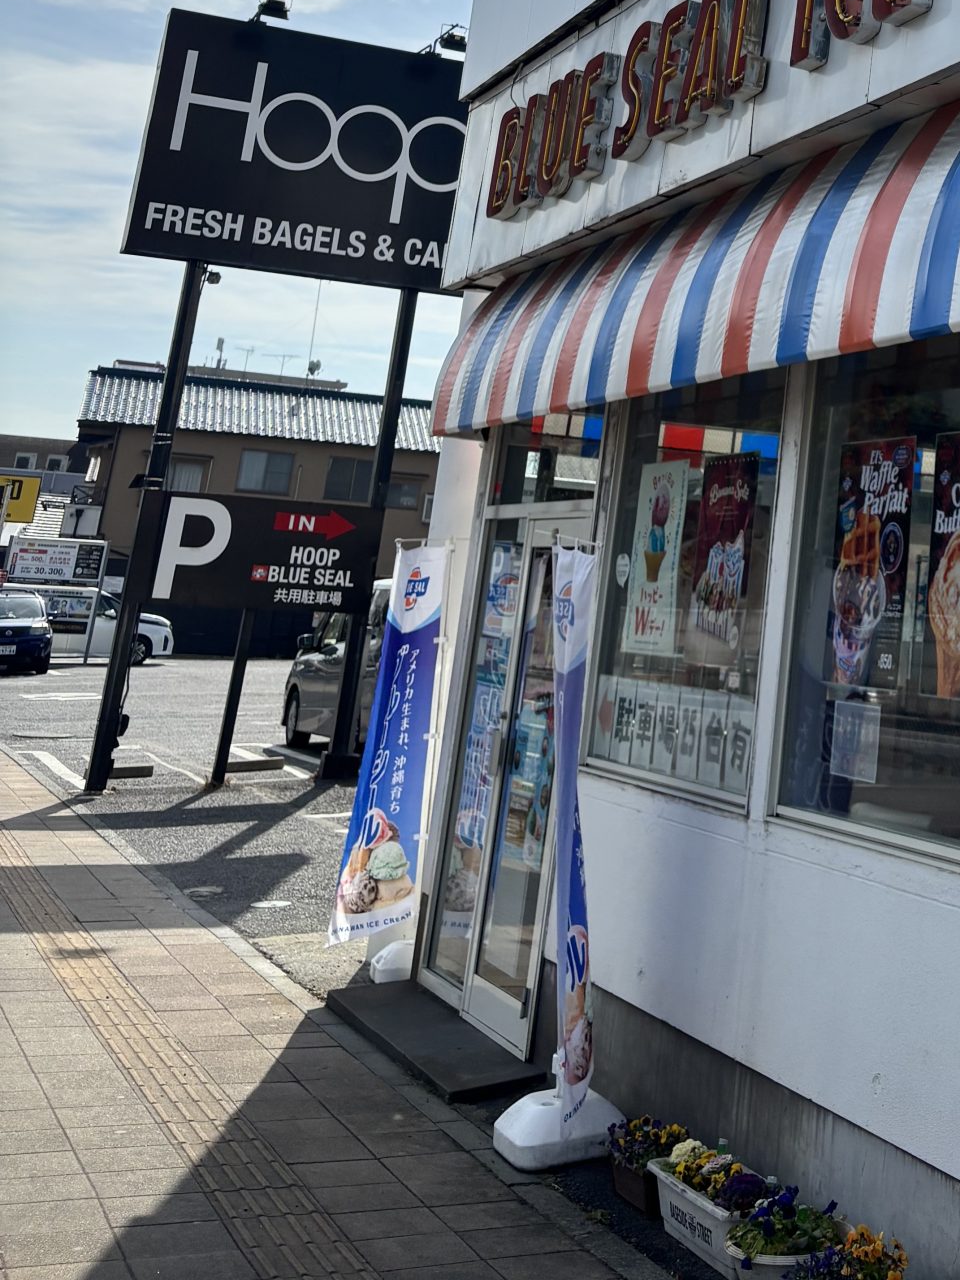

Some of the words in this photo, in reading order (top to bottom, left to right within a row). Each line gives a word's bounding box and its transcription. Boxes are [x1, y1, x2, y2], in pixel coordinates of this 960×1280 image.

[169, 49, 467, 224] Hoop
[486, 51, 621, 220] BLUE
[144, 201, 245, 242] FRESH
[252, 217, 367, 258] BAGELS
[373, 234, 394, 263] &
[860, 461, 900, 496] Waffle
[863, 482, 909, 522] Parfait
[151, 496, 232, 599] P
[288, 514, 316, 532] IN
[289, 545, 341, 567] HOOP
[267, 565, 310, 585] BLUE
[313, 568, 354, 588] SEAL
[273, 587, 342, 607] 共用駐車場
[390, 648, 420, 815] アメリカ生まれ、沖縄育ち
[367, 920, 380, 929] ICE
